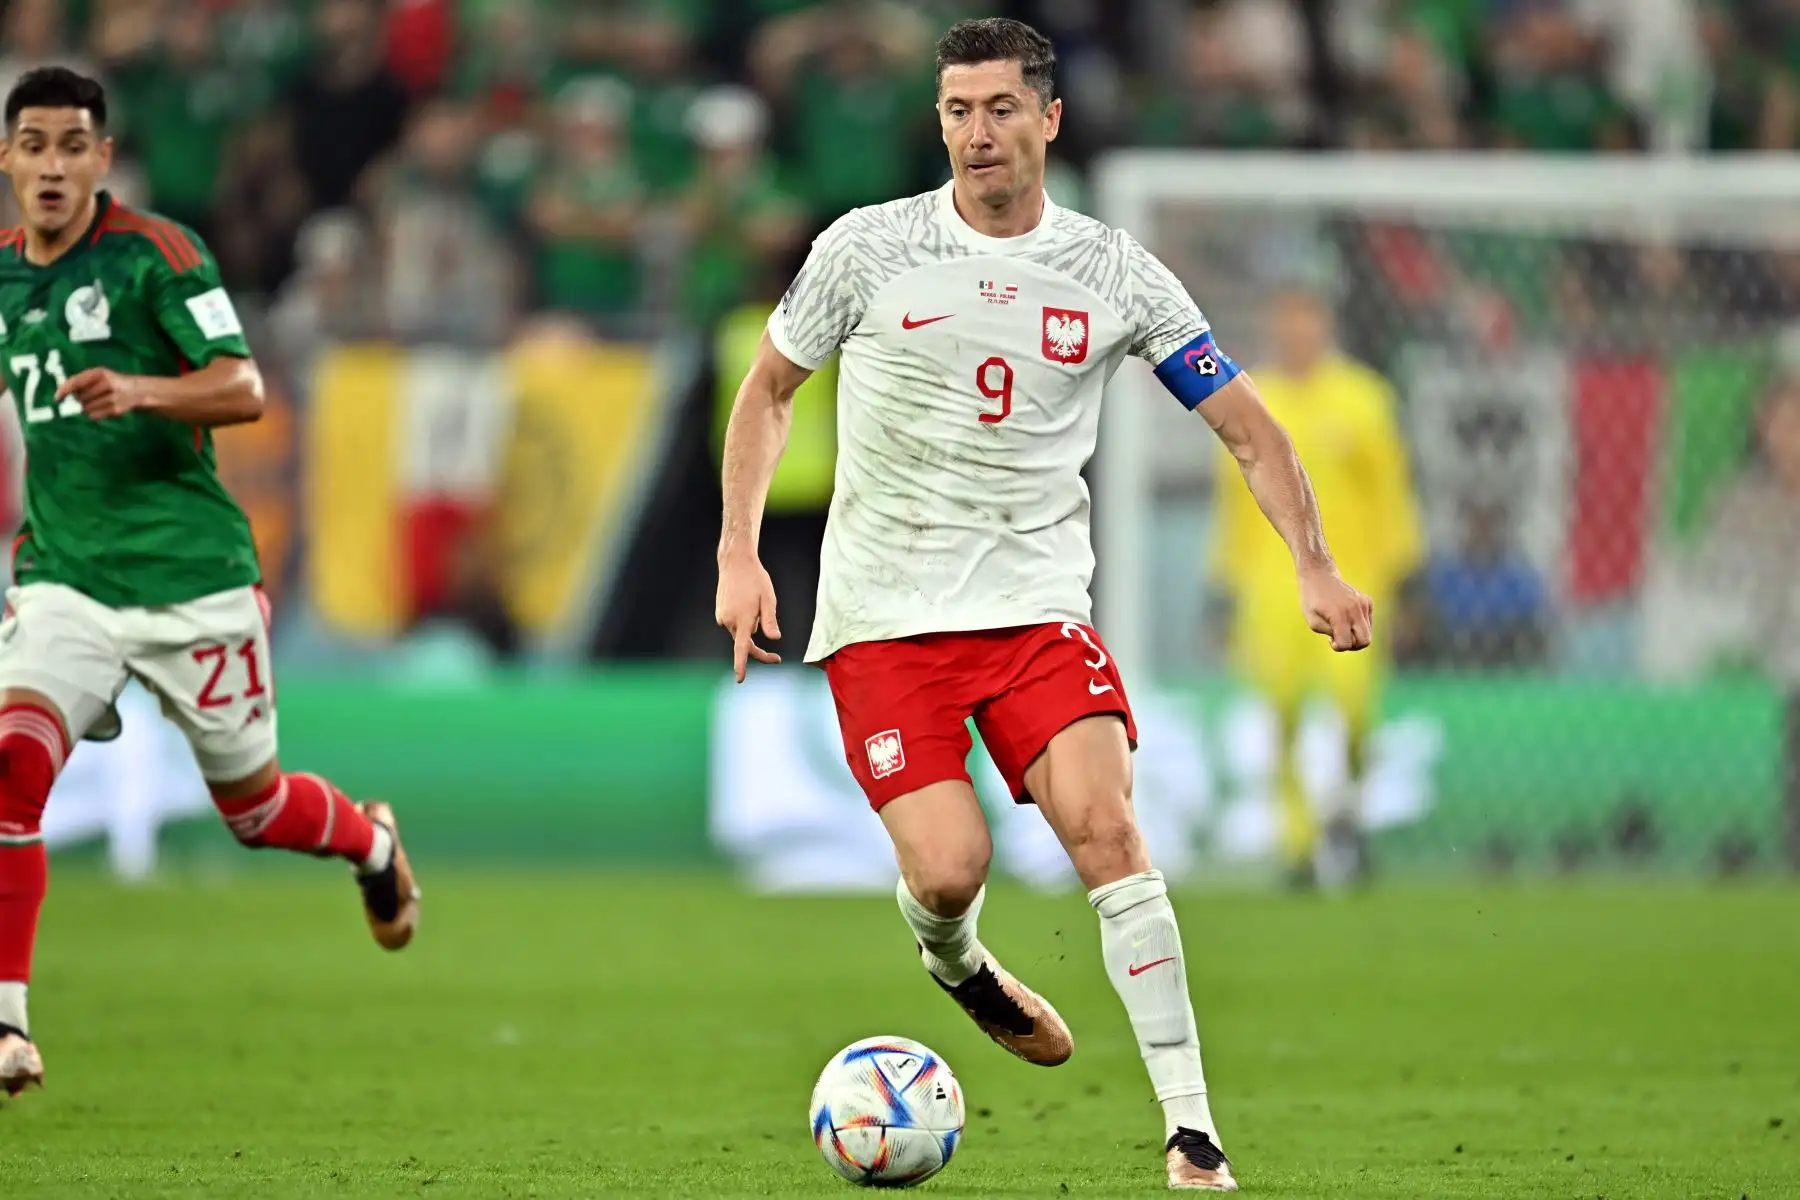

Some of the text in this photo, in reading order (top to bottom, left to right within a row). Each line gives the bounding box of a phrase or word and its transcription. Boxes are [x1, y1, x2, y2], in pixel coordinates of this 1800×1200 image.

[10, 349, 83, 423] 21
[976, 356, 1014, 424] 9
[192, 639, 265, 709] 21
